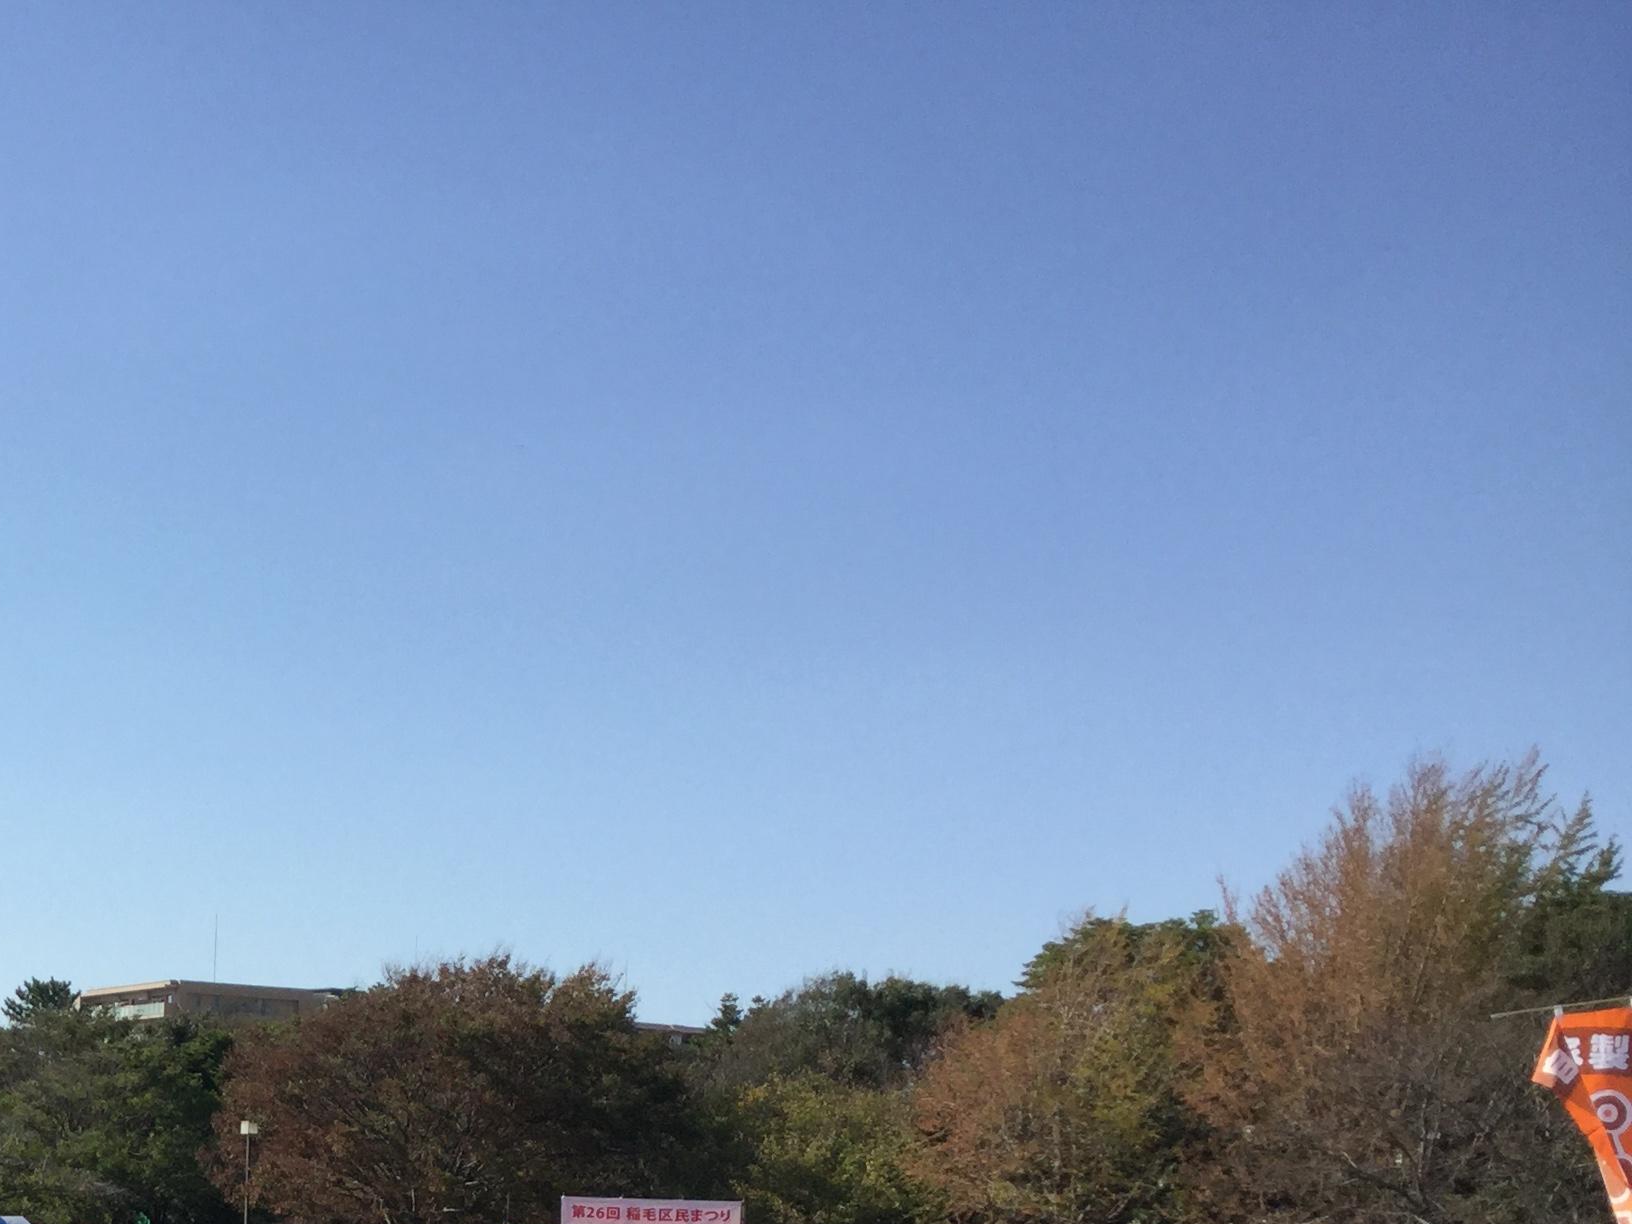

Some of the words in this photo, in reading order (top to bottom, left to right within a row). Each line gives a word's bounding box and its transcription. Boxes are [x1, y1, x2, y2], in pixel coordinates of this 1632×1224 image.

[572, 1204, 621, 1220] 第26回
[626, 1206, 731, 1222] 稲毛区民まつり
